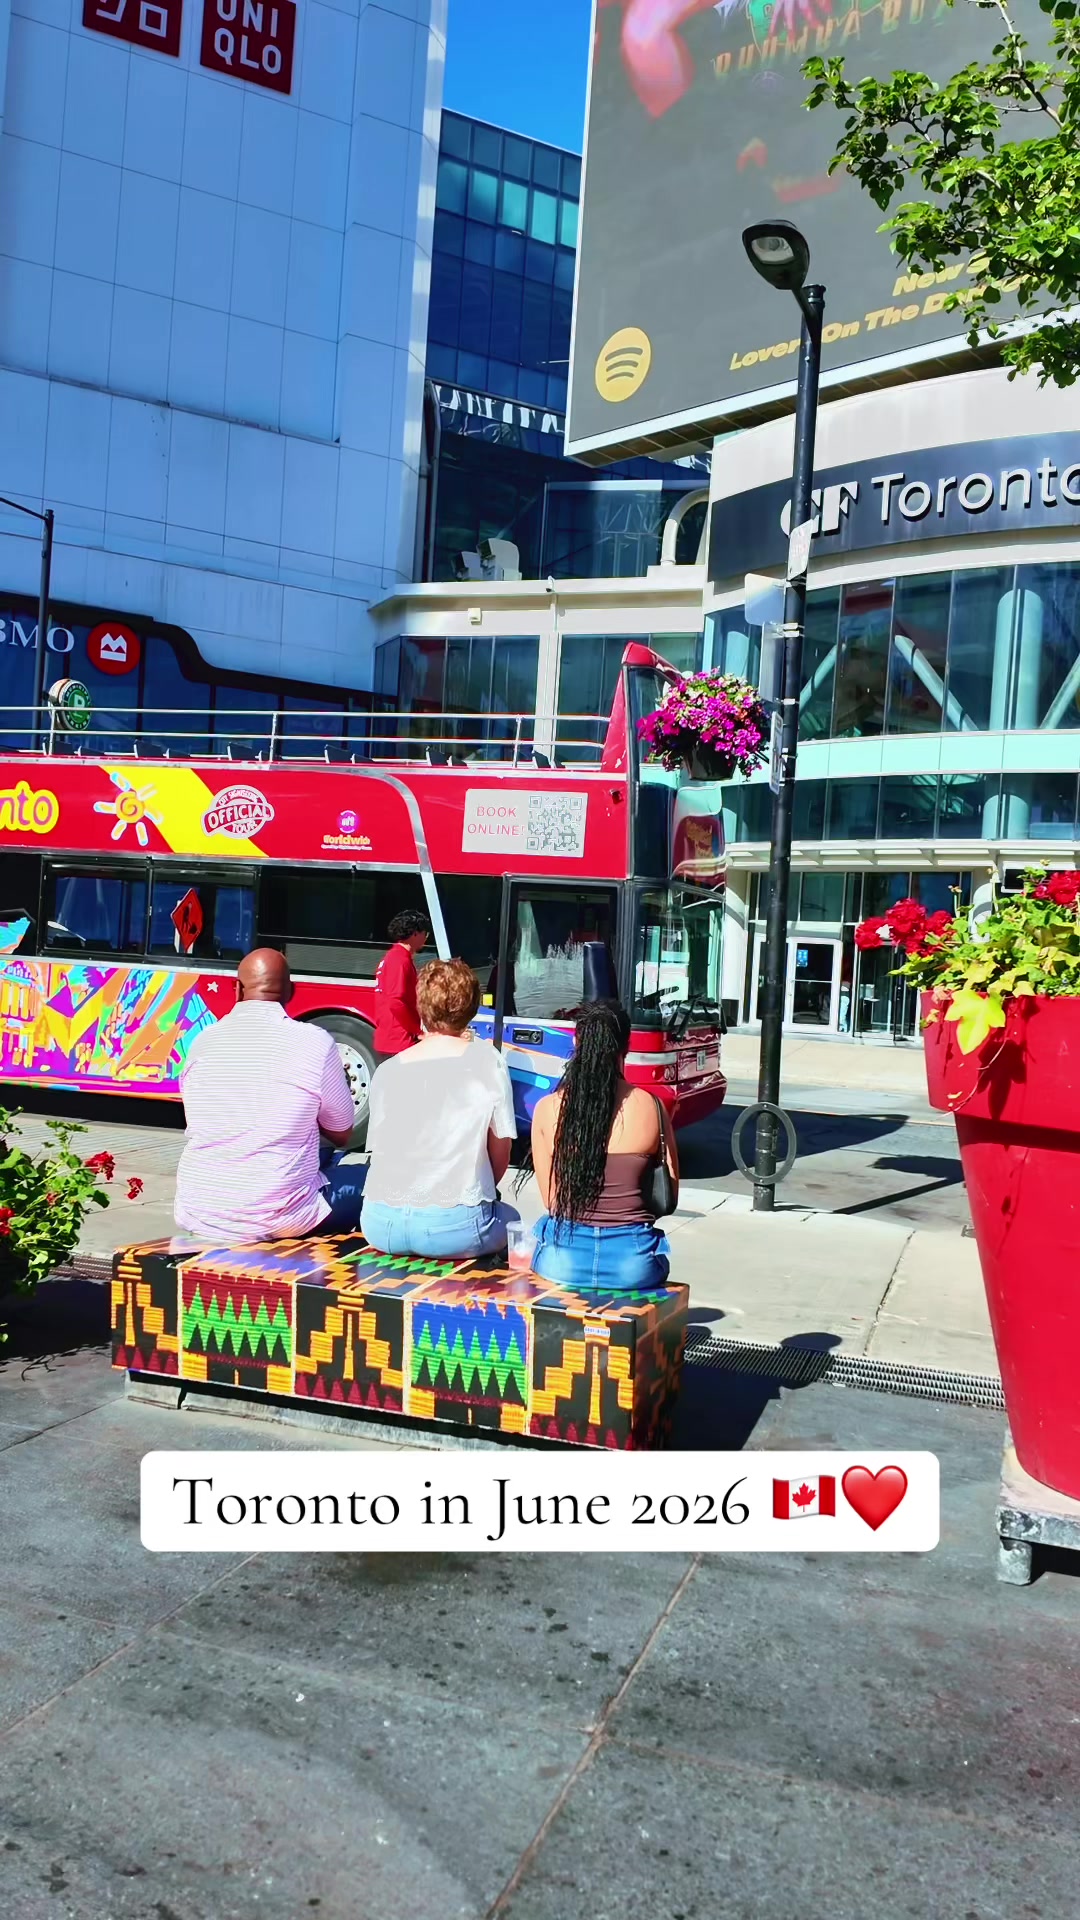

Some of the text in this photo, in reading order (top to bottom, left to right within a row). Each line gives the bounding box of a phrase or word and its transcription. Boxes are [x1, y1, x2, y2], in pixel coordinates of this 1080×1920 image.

[214, 27, 282, 75] QLO
[892, 263, 965, 297] New
[729, 303, 920, 371] Lover On The
[208, 804, 271, 829] OFFICIAL
[476, 806, 517, 818] BOOK
[232, 820, 259, 834] TOUR
[467, 822, 525, 836] ONLINE!
